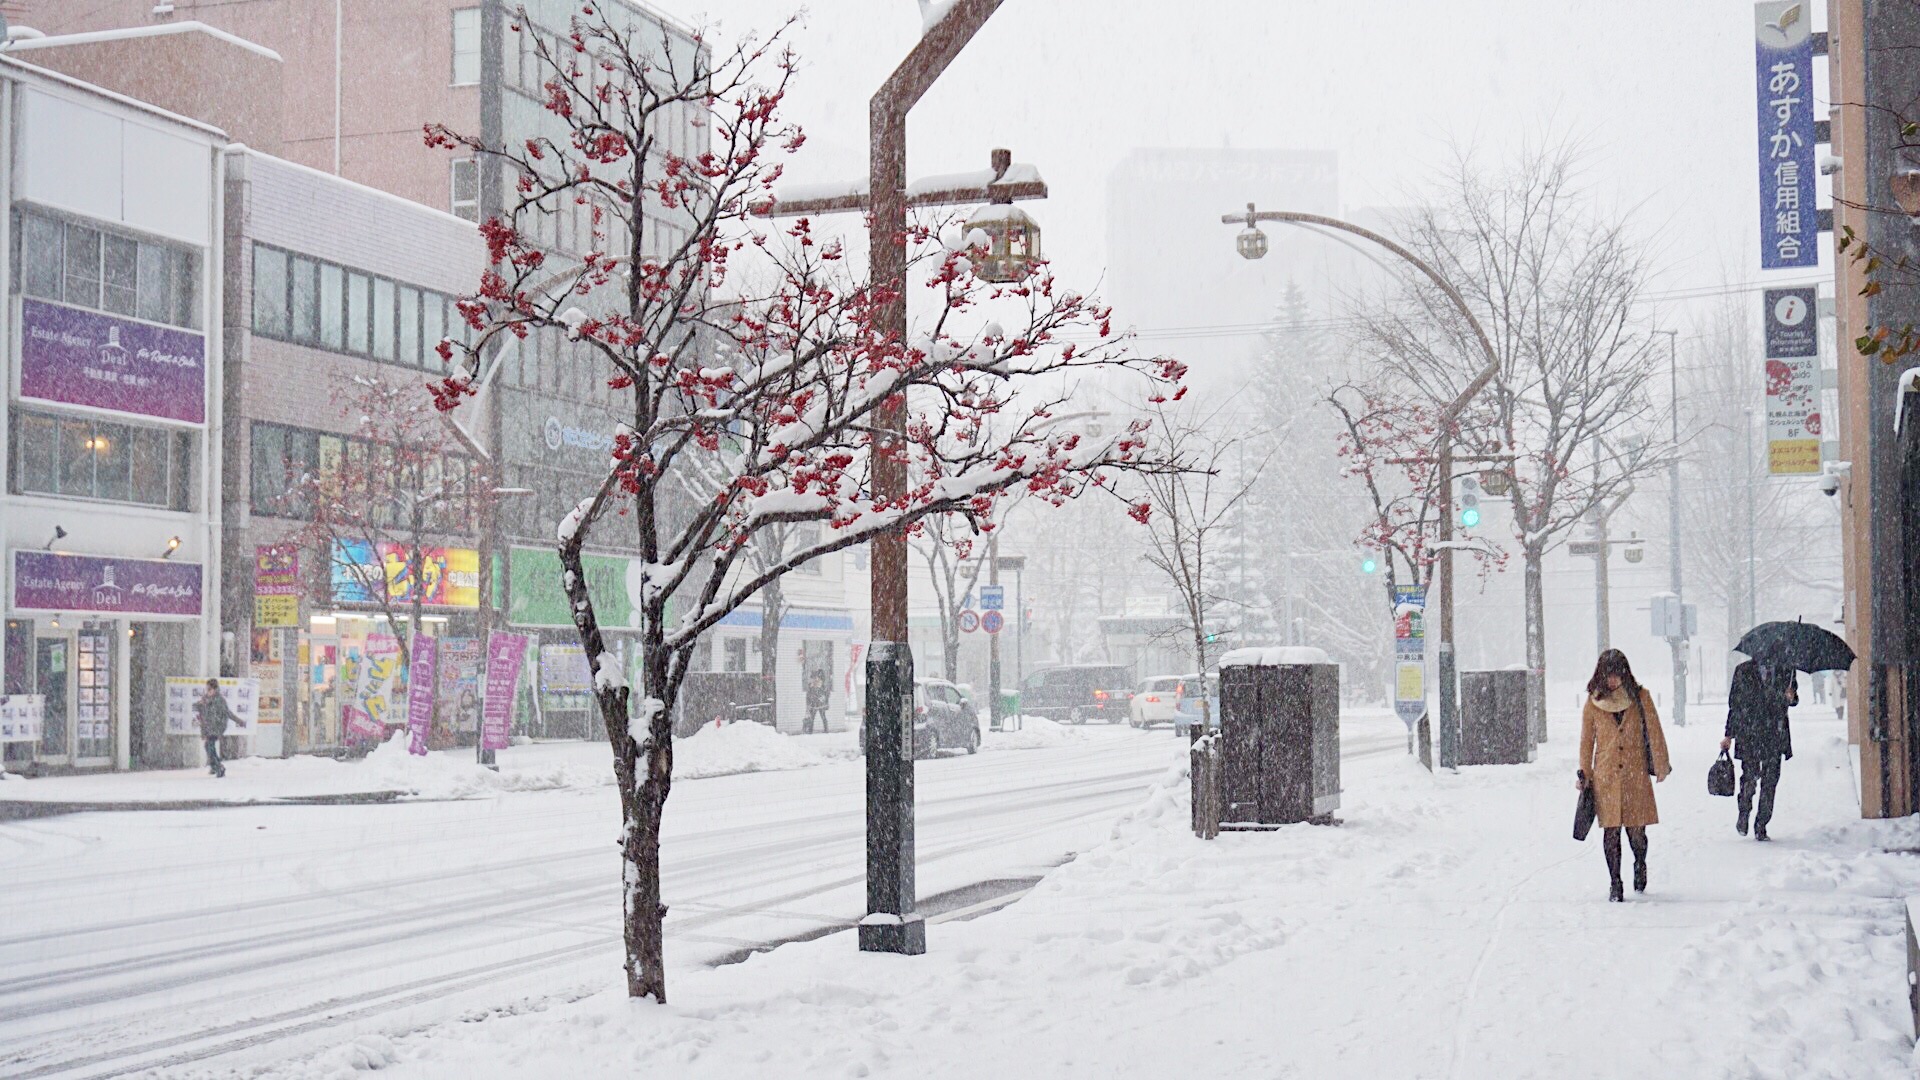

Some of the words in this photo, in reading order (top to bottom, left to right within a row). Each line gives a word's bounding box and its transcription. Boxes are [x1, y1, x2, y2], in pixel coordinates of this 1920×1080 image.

[1769, 61, 1803, 260] あすか信用組合
[31, 325, 59, 341] Estate
[61, 331, 92, 348] Agency
[1780, 330, 1805, 338] Tourist
[1770, 338, 1813, 346] Information
[101, 348, 127, 366] Deal
[1787, 428, 1800, 438] 8F
[23, 575, 53, 589] Estate
[54, 577, 86, 592] Agency
[96, 591, 122, 605] Deal
[1396, 653, 1424, 661] 中島公園
